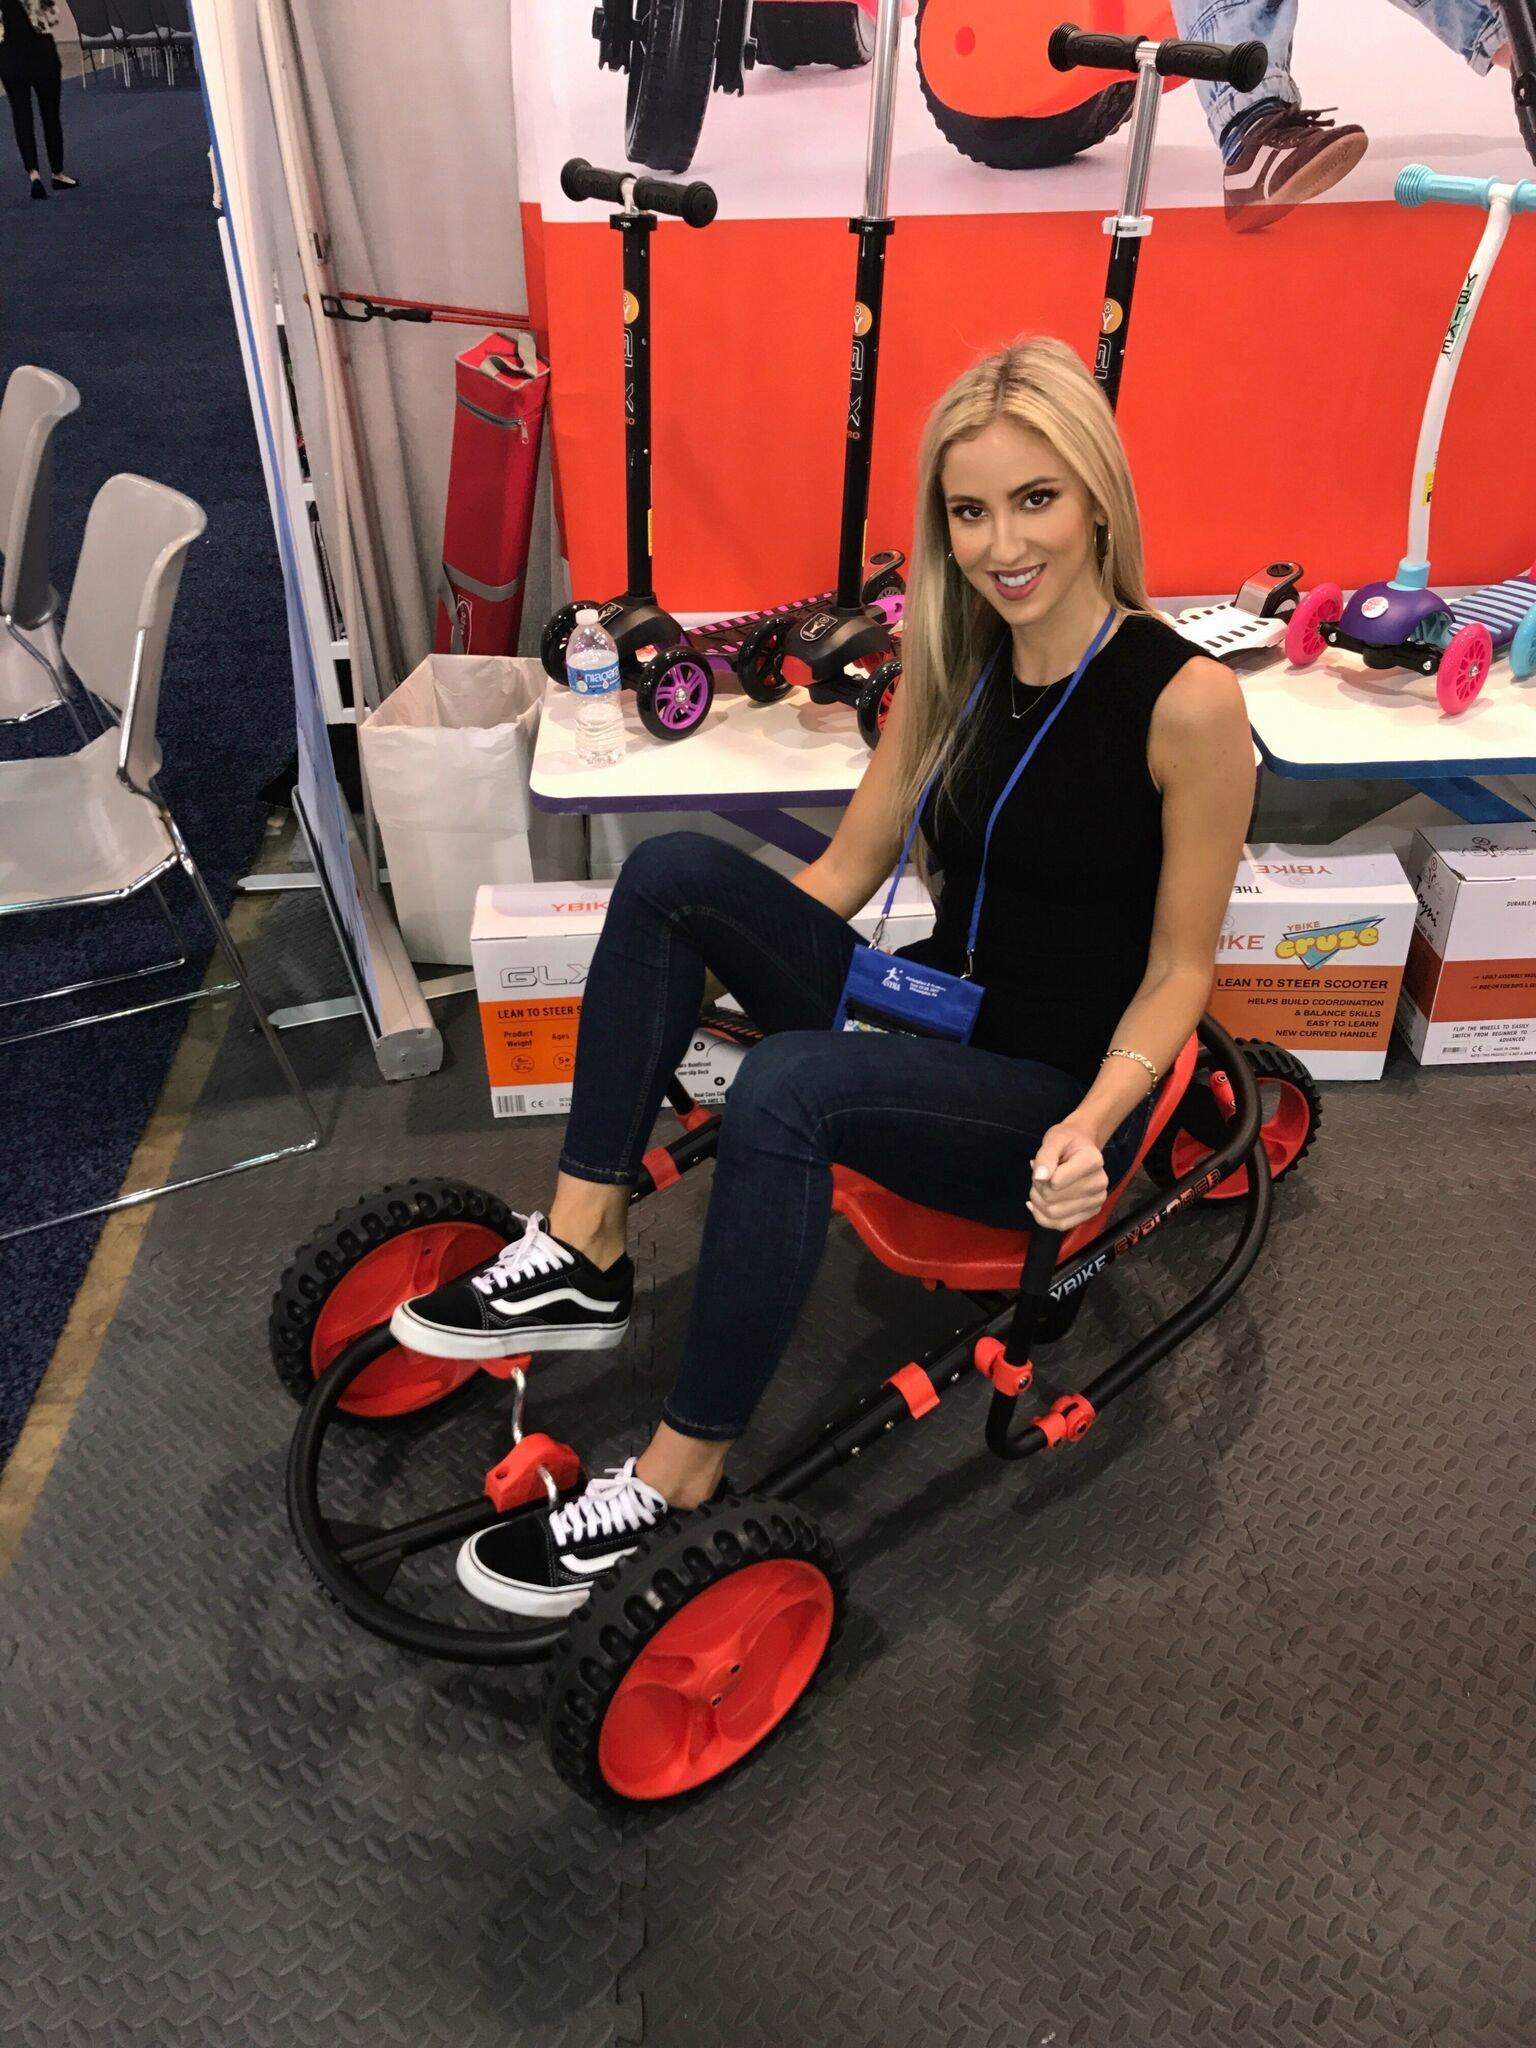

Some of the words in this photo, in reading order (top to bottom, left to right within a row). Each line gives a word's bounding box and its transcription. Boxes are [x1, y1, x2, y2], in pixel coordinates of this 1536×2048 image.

[1441, 273, 1479, 354] YBIKE
[1253, 865, 1334, 874] YBIKE
[552, 901, 609, 912] YBIK
[1287, 921, 1320, 931] YBIKE
[1219, 935, 1265, 950] IKE
[1217, 978, 1251, 987] LEAN
[1256, 978, 1273, 987] TO
[1277, 979, 1321, 988] STEER
[1324, 979, 1388, 989] SCOOTER
[1312, 998, 1384, 1006] COORDINATION
[498, 1008, 524, 1019] LEAN
[527, 1007, 540, 1017] TO
[543, 1006, 574, 1016] STEER
[504, 1030, 533, 1038] Product
[1048, 1254, 1106, 1302] YBIKE
